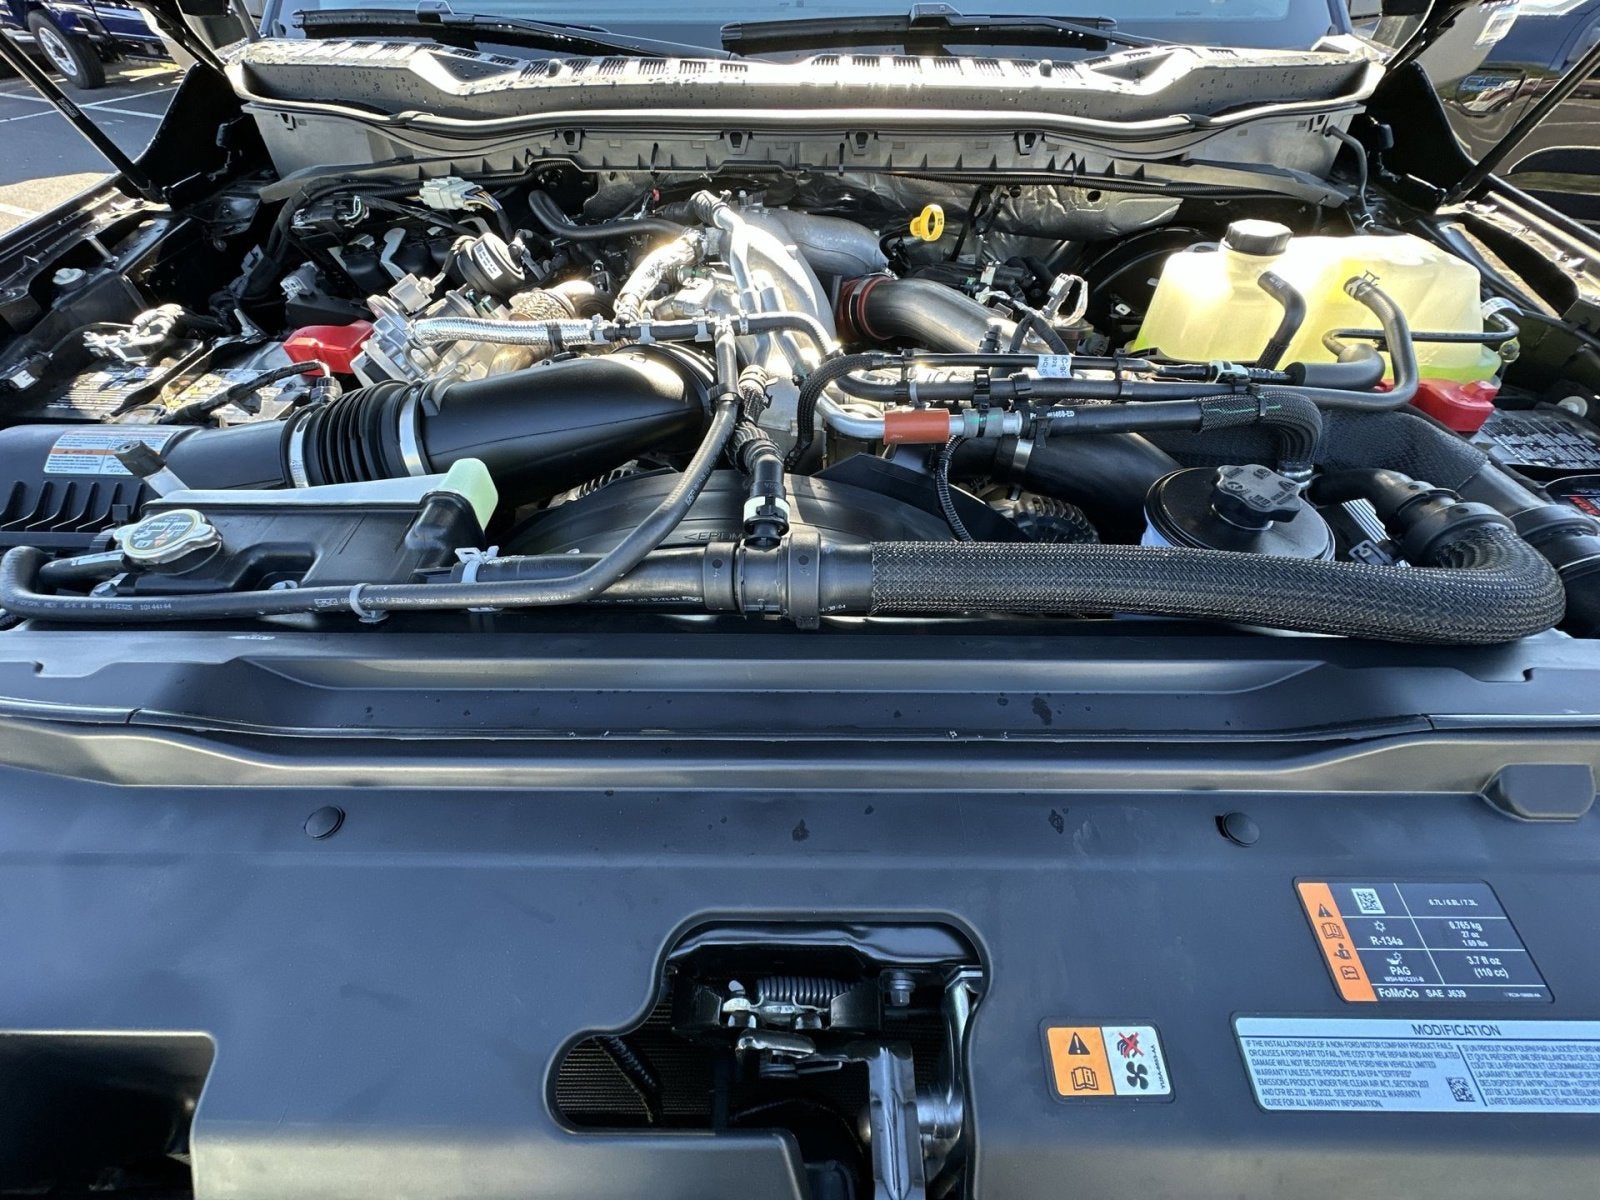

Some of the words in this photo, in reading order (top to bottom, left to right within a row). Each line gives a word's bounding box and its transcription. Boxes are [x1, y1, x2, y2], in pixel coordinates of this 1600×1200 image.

[1448, 920, 1471, 930] 0.765
[1470, 922, 1483, 932] kg
[1370, 936, 1404, 946] R-134a
[1466, 956, 1480, 965] 3.7
[1490, 957, 1502, 965] oz
[1390, 966, 1412, 976] PAG
[1474, 968, 1493, 978] (110
[1494, 969, 1510, 979] cc)
[1378, 988, 1420, 998] FoMoCo
[1426, 989, 1444, 998] SAE
[1447, 990, 1467, 998] J639
[1412, 1024, 1502, 1036] MODIFICATION
